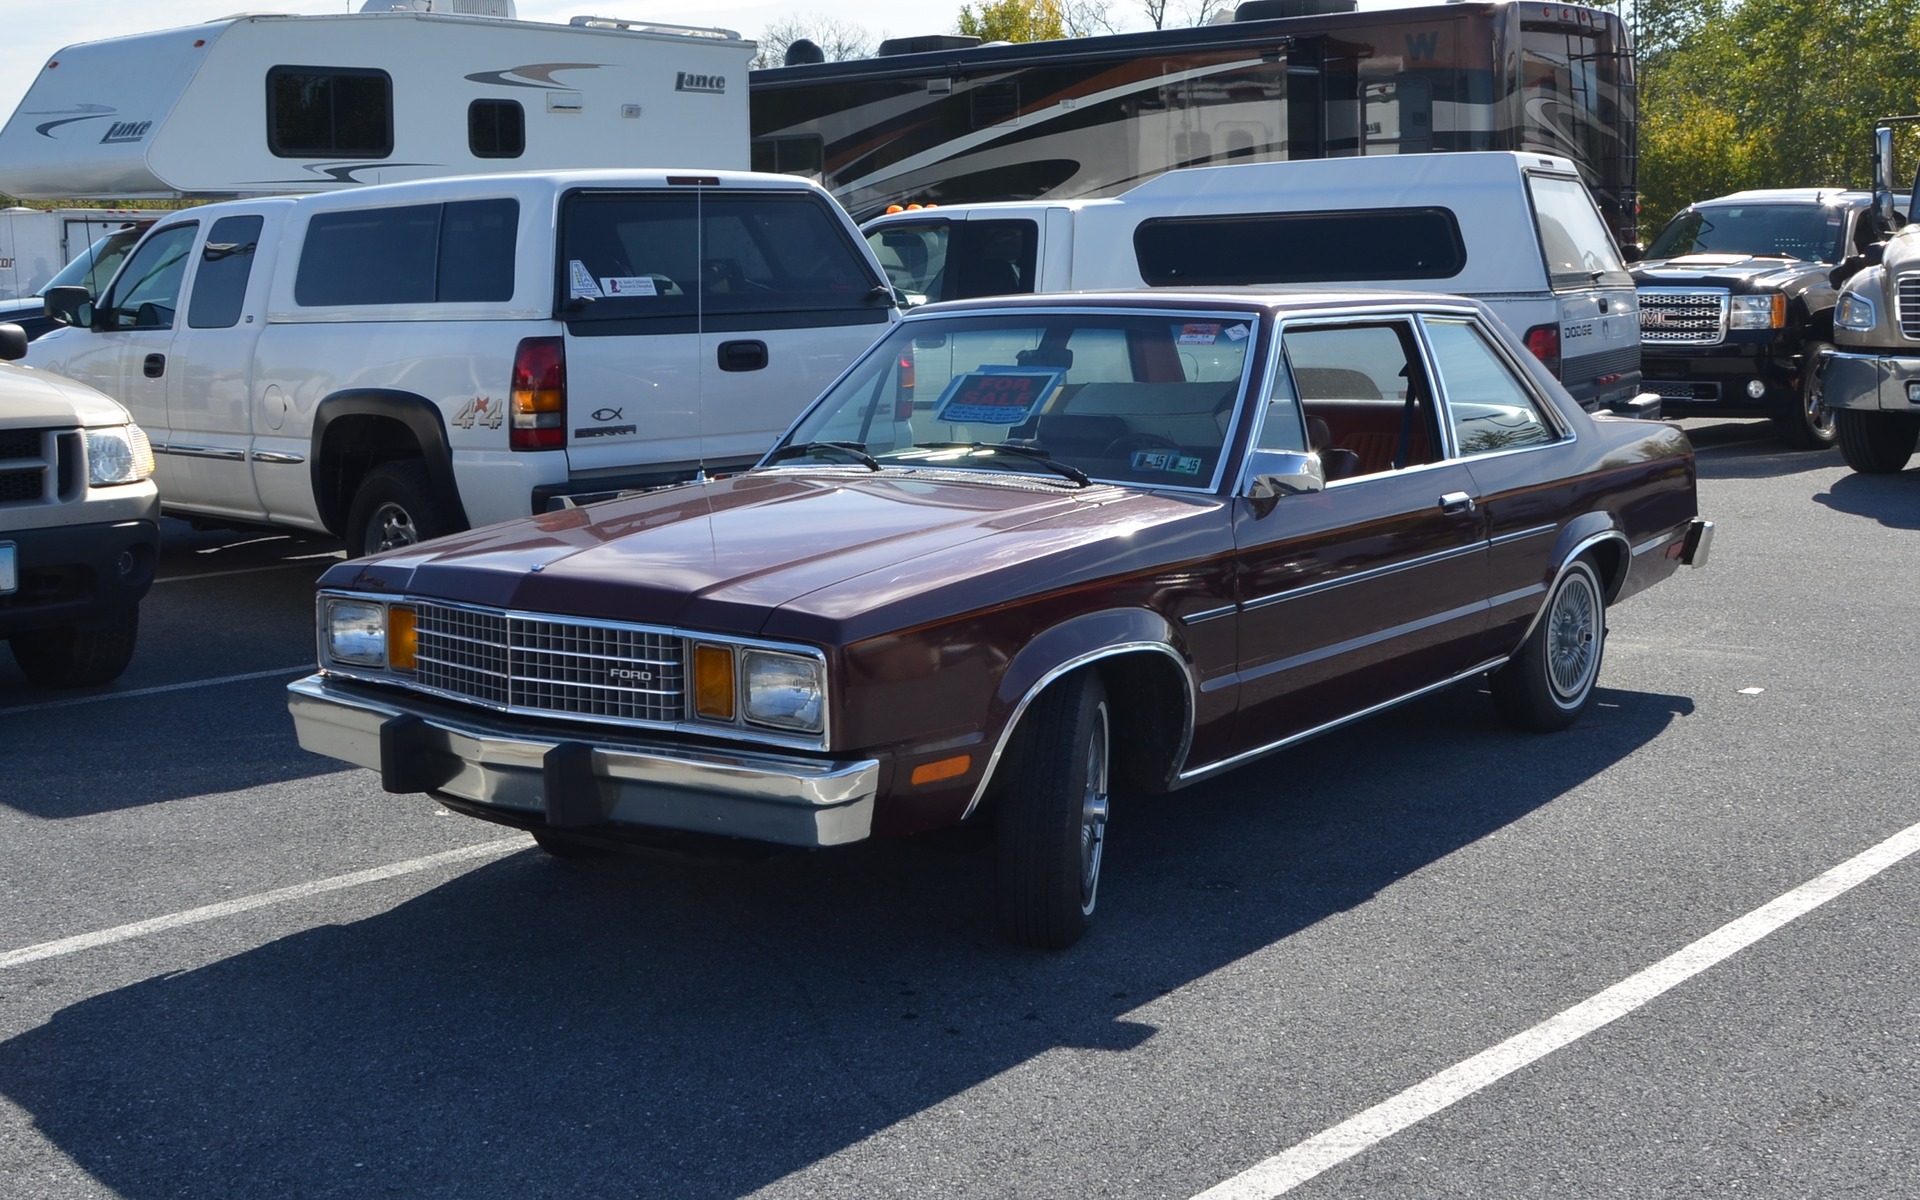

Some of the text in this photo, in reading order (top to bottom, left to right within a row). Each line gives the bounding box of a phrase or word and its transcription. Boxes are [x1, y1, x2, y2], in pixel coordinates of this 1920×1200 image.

[674, 71, 726, 95] Lance
[98, 120, 153, 145] Lance
[0, 257, 15, 269] or
[1564, 324, 1593, 339] DODGE
[977, 377, 1032, 390] FOR
[960, 390, 1034, 406] SALE
[610, 668, 652, 681] FORD
